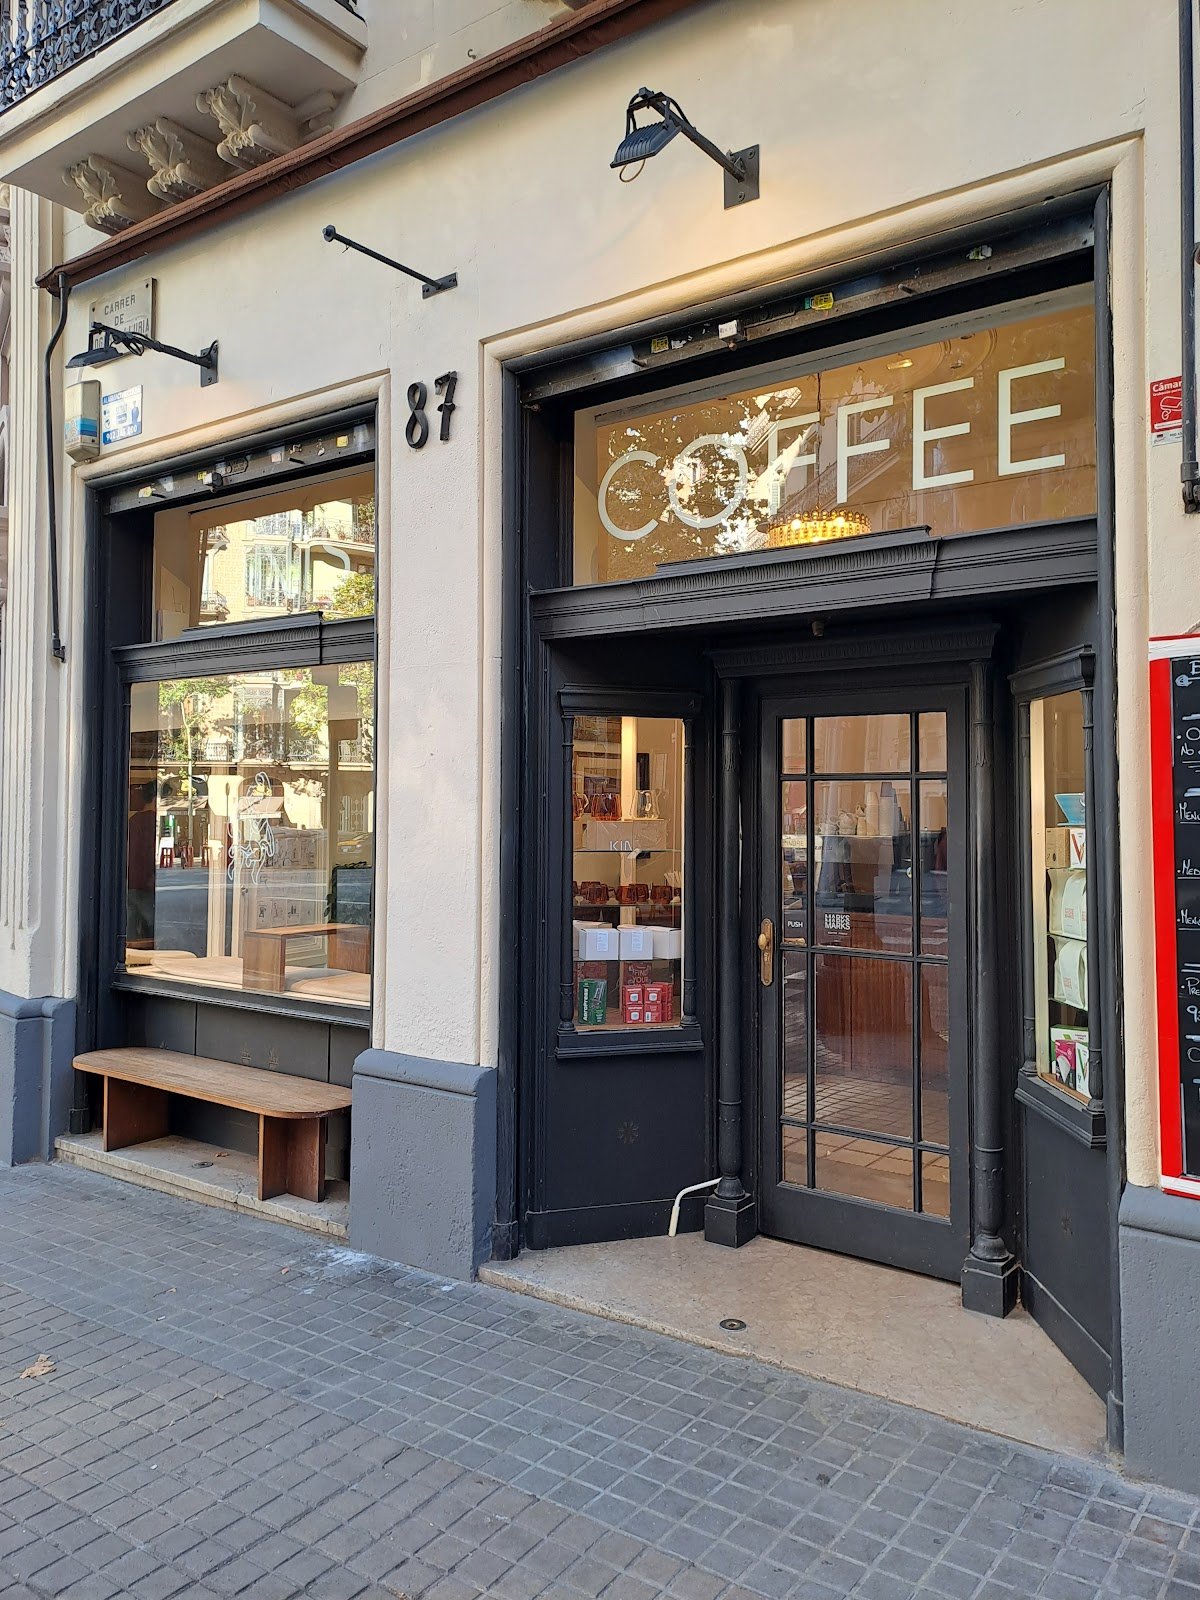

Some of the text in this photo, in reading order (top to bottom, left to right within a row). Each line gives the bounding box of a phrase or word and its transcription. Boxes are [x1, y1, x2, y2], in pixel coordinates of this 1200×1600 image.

[104, 294, 136, 316] CARRER
[114, 314, 125, 327] DE
[405, 371, 458, 449] 87
[598, 357, 1066, 541] COFFEE
[787, 920, 804, 929] PUSH
